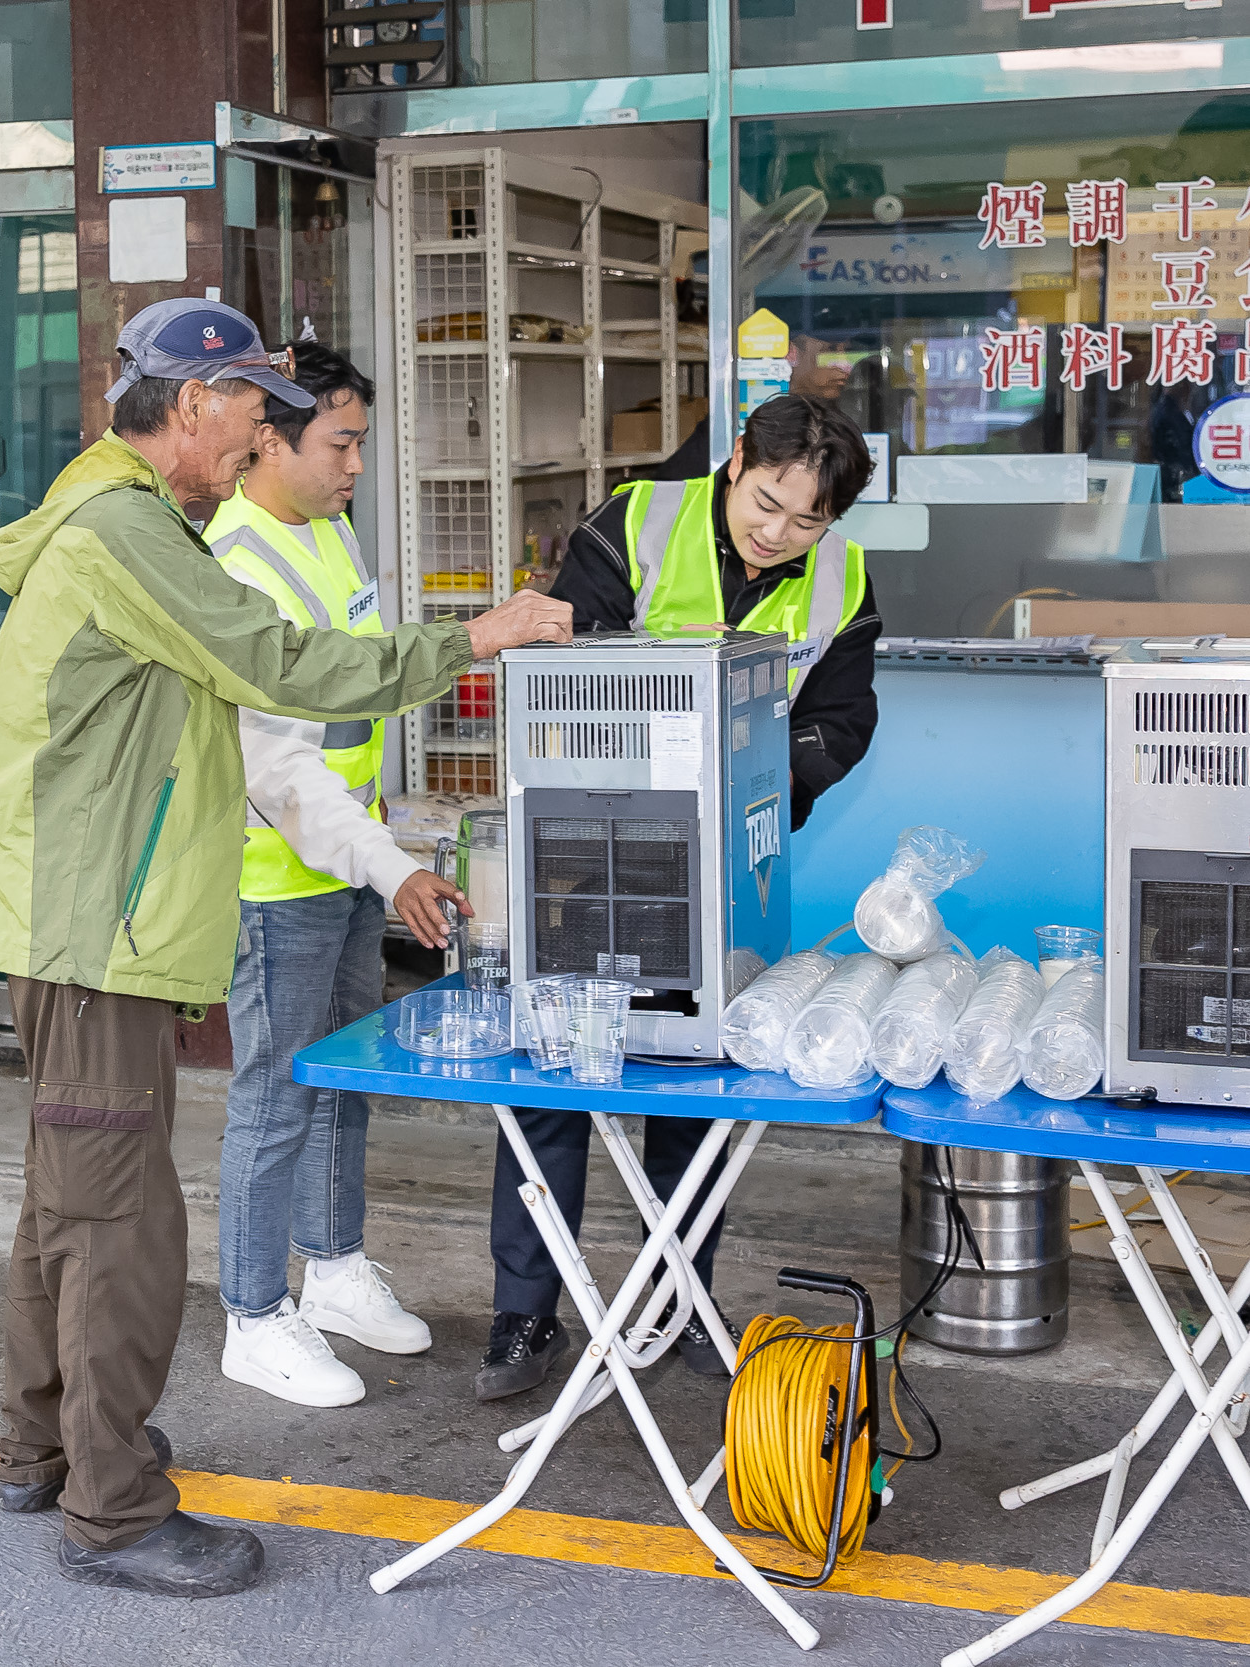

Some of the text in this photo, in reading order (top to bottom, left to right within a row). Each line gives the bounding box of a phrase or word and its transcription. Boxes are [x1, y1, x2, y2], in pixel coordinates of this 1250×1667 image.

[349, 591, 375, 620] STAFF
[788, 646, 816, 662] TAFF
[746, 803, 781, 873] TERRA
[481, 967, 510, 979] TERR
